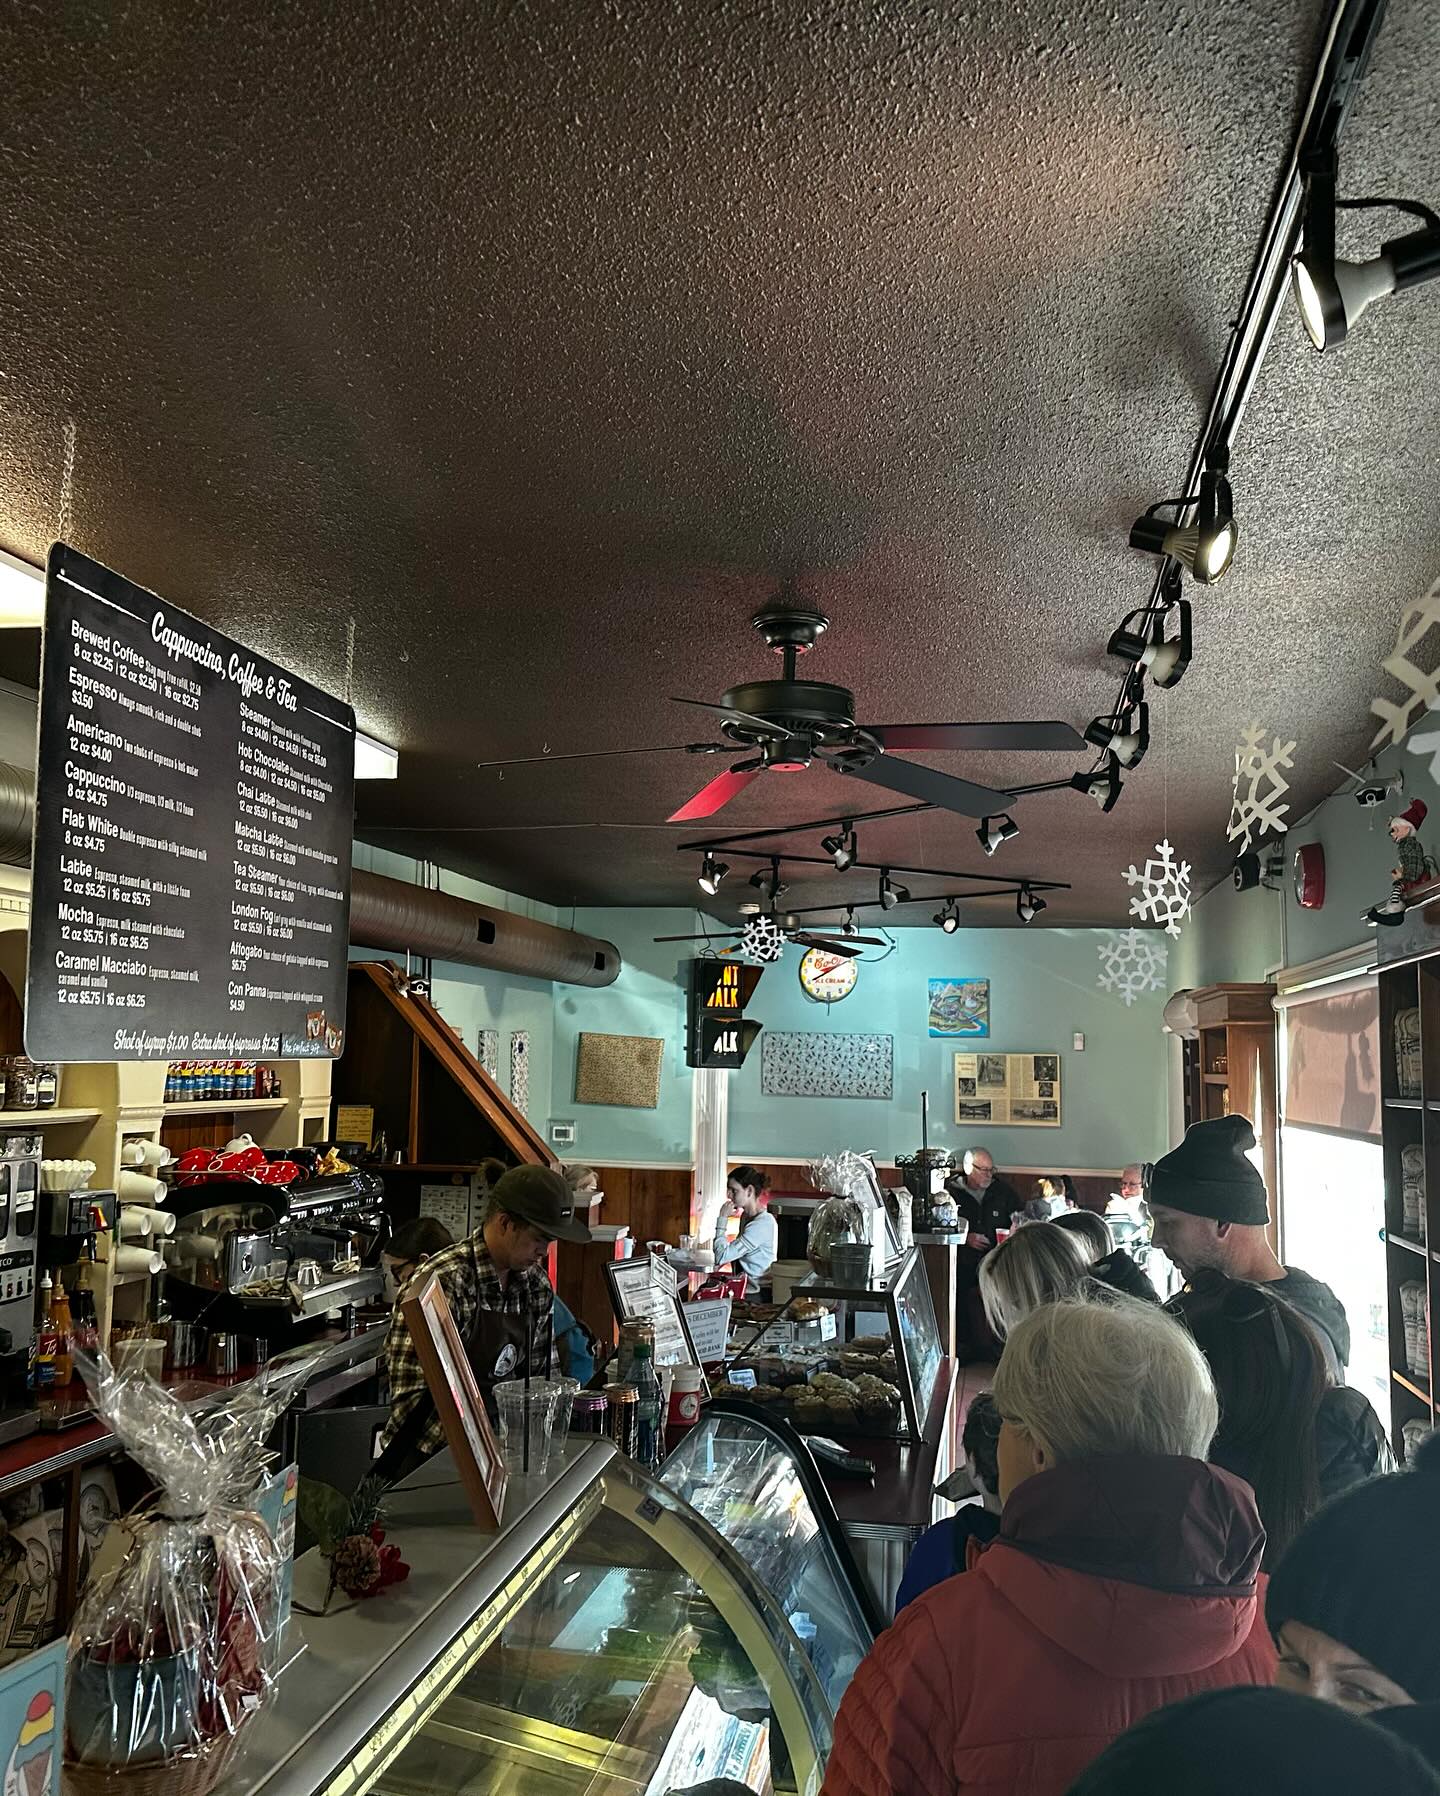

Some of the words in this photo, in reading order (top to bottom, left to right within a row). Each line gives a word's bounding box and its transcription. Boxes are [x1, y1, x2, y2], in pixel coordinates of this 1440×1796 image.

[71, 619, 110, 652] Brewed
[112, 640, 144, 668] Coffee
[151, 611, 226, 679] Cappuccino,
[228, 652, 263, 698] Coffee
[265, 675, 275, 699] &
[276, 678, 297, 712] Tea
[69, 666, 117, 700] Espresso
[73, 642, 79, 656] 8
[81, 649, 91, 662] oz
[92, 651, 113, 672] $2.25
[119, 664, 127, 678] 12
[127, 670, 137, 683] oz
[138, 672, 157, 691] $2.50
[164, 685, 171, 698] 16
[172, 691, 181, 702] oz
[181, 693, 198, 710] $2.75
[71, 689, 93, 709] $3.50
[239, 701, 270, 727] Steamer
[66, 713, 122, 748] Americano
[69, 736, 78, 751] 12
[79, 742, 90, 755] oz
[90, 744, 112, 762] $4.00
[237, 741, 252, 759] Hot
[253, 748, 289, 774] Chocolate
[64, 760, 125, 794] Cappuccino
[67, 782, 73, 797] 8
[74, 788, 85, 800] oz
[86, 788, 107, 807] $4.75
[237, 781, 253, 799] Chai
[254, 787, 275, 806] Latte
[62, 807, 84, 828] Flat
[87, 814, 118, 837] White
[234, 820, 262, 841] Matcha
[263, 829, 283, 847] Latte
[64, 829, 70, 844] 8
[72, 835, 83, 847] oz
[84, 834, 105, 852] $4.75
[60, 854, 92, 877] Latte
[233, 860, 246, 876] Tea
[247, 864, 278, 883] Steamer
[63, 877, 72, 891] 12
[73, 882, 83, 894] oz
[84, 881, 105, 898] $5.25
[111, 887, 120, 900] 16
[120, 891, 130, 902] oz
[131, 891, 150, 906] $5.75
[58, 902, 93, 924] Mocha
[231, 900, 258, 918] London
[260, 906, 273, 924] Fog
[61, 925, 70, 939] 12
[71, 929, 81, 940] oz
[82, 928, 103, 944] $5.75
[109, 932, 117, 945] 16
[118, 936, 128, 947] oz
[129, 935, 148, 949] $6.25
[55, 950, 99, 971] Caramel
[101, 955, 146, 975] Macciato
[229, 940, 262, 962] Affogato
[231, 958, 246, 971] $6.75
[57, 988, 66, 1002] 12
[67, 992, 78, 1003] oz
[79, 990, 100, 1004] $5.75
[106, 992, 114, 1005] 16
[115, 995, 125, 1006] oz
[126, 993, 145, 1007] $6.25
[227, 980, 243, 995] Con
[244, 982, 266, 997] Panna
[229, 999, 245, 1011] $4.50
[113, 1029, 136, 1049] Shot
[134, 1029, 146, 1056] of
[143, 1035, 166, 1056] syrup
[166, 1030, 188, 1053] $1.00
[191, 1031, 212, 1050] Extra
[211, 1031, 228, 1050] shot
[226, 1032, 236, 1056] of
[234, 1037, 260, 1055] espresso
[261, 1032, 279, 1053] $1.25
[713, 1030, 738, 1053] ALK
[692, 1310, 723, 1322] DECEMBER
